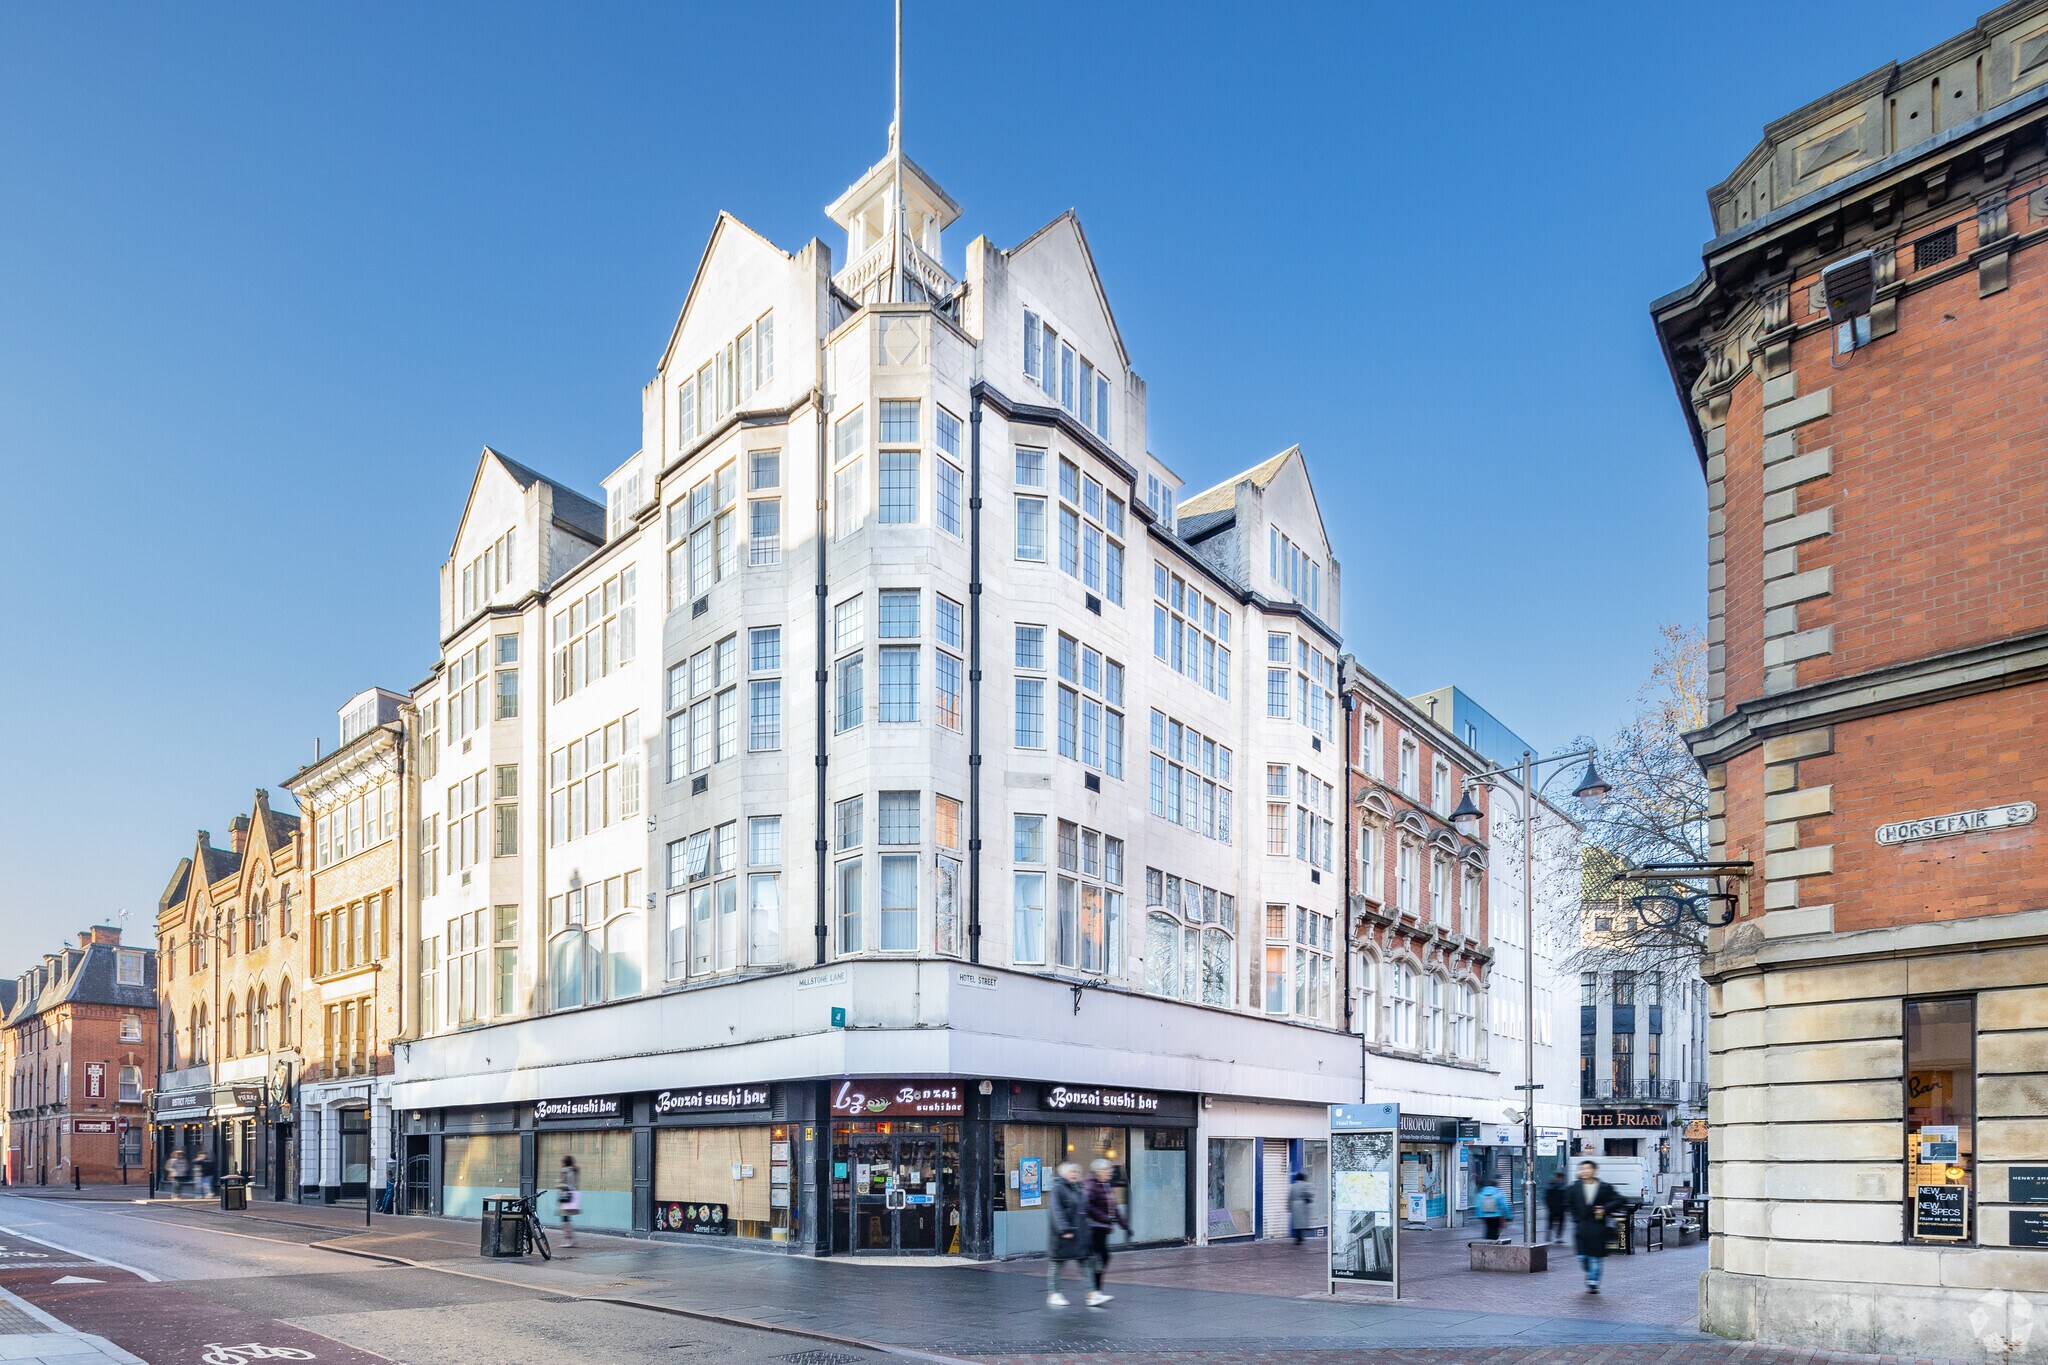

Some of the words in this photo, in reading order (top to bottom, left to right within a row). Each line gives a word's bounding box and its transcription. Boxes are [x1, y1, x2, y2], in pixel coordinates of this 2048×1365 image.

[1885, 812, 1988, 841] HORSEFAIR
[799, 974, 828, 987] MILLSTONE
[830, 971, 845, 982] LANE
[959, 973, 976, 984] HOTEL
[978, 976, 997, 987] STREET
[655, 1091, 702, 1113] Bonzai
[704, 1088, 741, 1107] sushi
[743, 1089, 766, 1105] bar
[896, 1087, 957, 1103] Bonzai
[1048, 1087, 1100, 1108] Bonzai
[1103, 1092, 1136, 1109] sushi
[1138, 1095, 1158, 1109] bar
[534, 1100, 571, 1118] Bonzai
[571, 1099, 598, 1114] sushi
[599, 1099, 617, 1113] bar
[916, 1103, 945, 1111] sushi
[1581, 1113, 1613, 1126] THE
[1616, 1113, 1665, 1126] FRIARY
[1935, 1193, 1958, 1201] YEAR
[1931, 1208, 1961, 1216] SPECS
